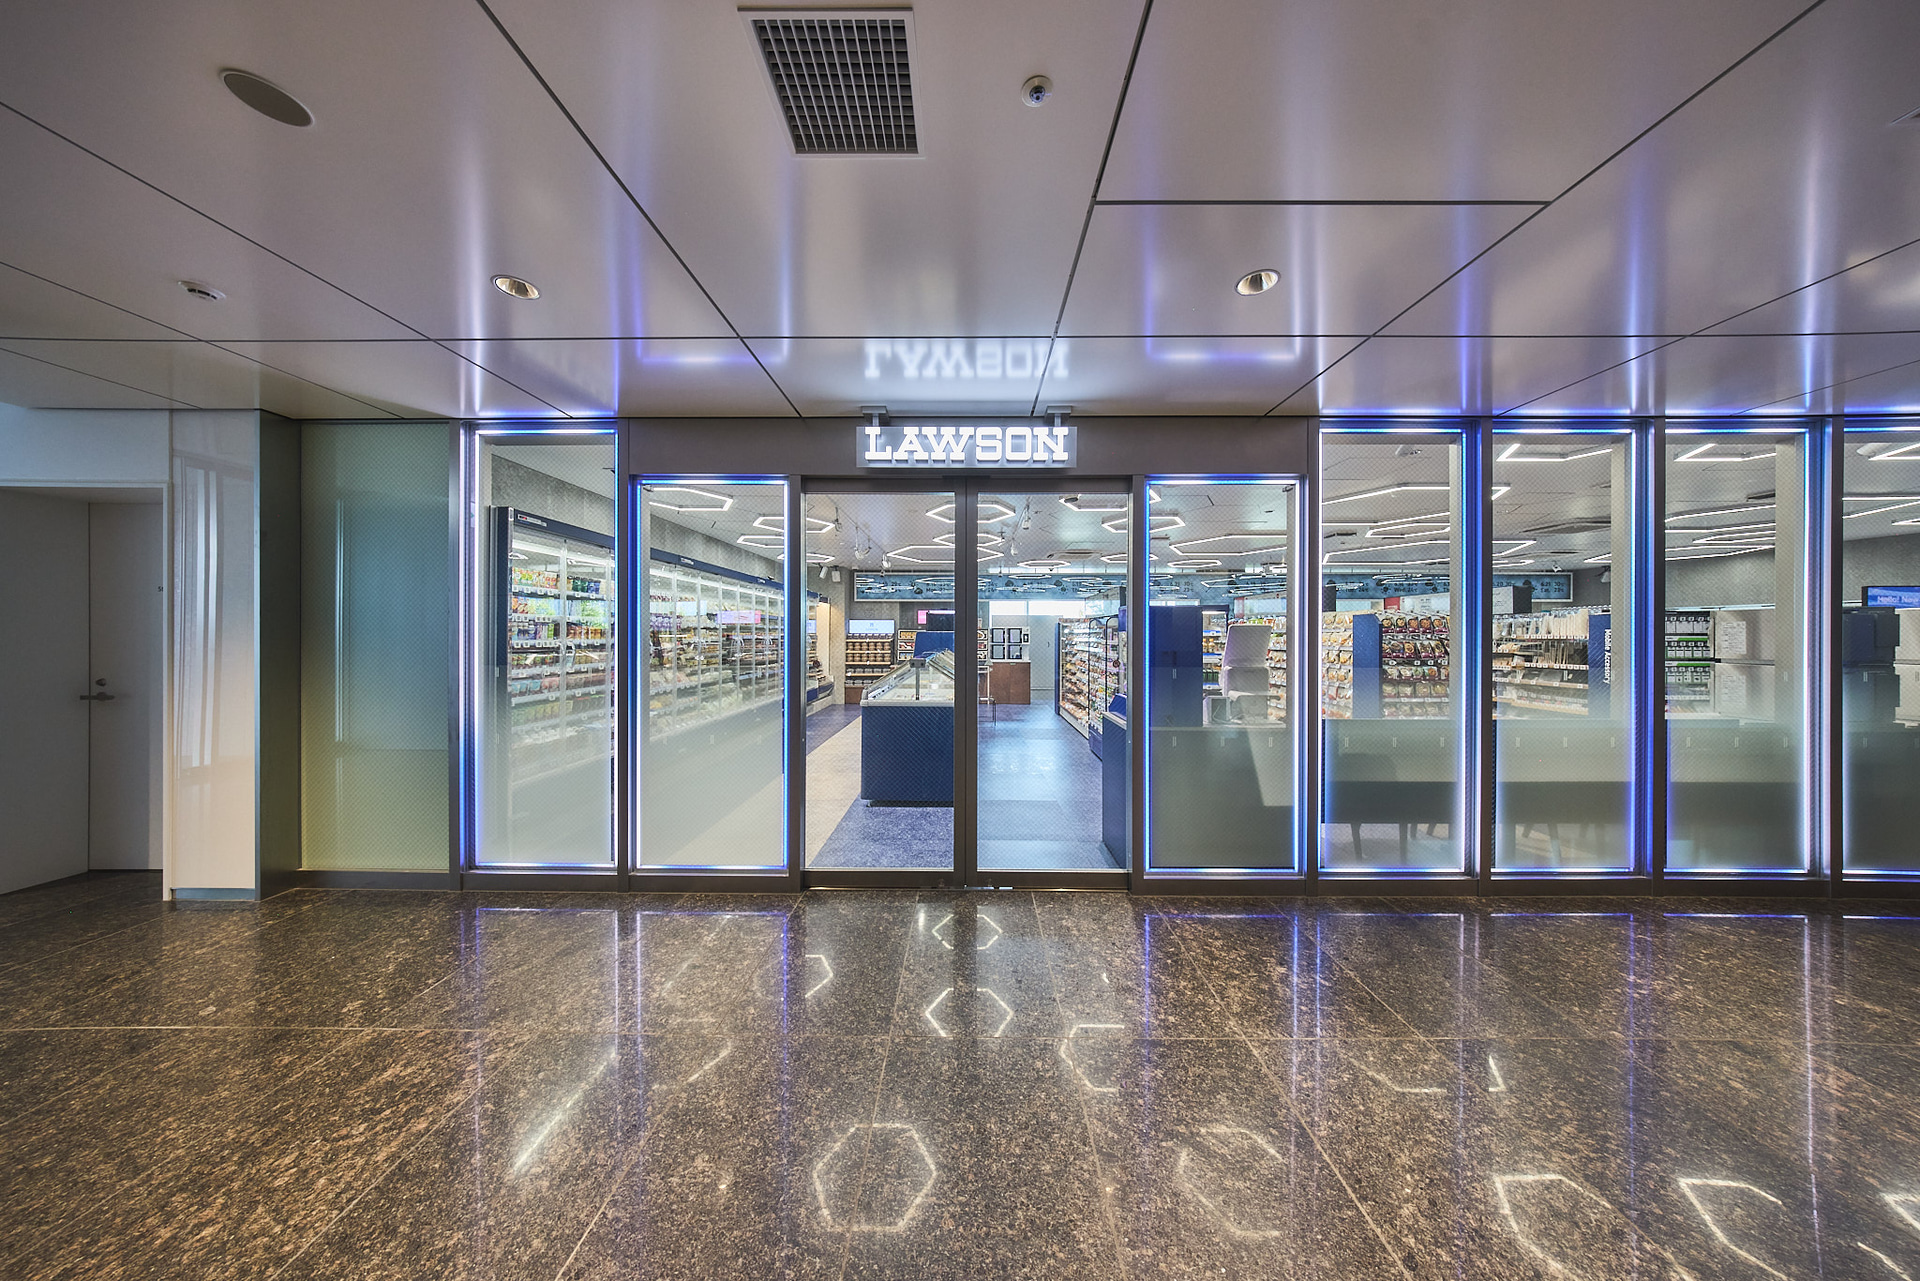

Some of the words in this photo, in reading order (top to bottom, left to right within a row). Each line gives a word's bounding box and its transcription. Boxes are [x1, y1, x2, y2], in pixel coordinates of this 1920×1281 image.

[864, 426, 1069, 461] LAWSON
[1877, 595, 1900, 604] Hello!
[1604, 629, 1612, 651] Mobile
[1603, 651, 1612, 684] Accessory
